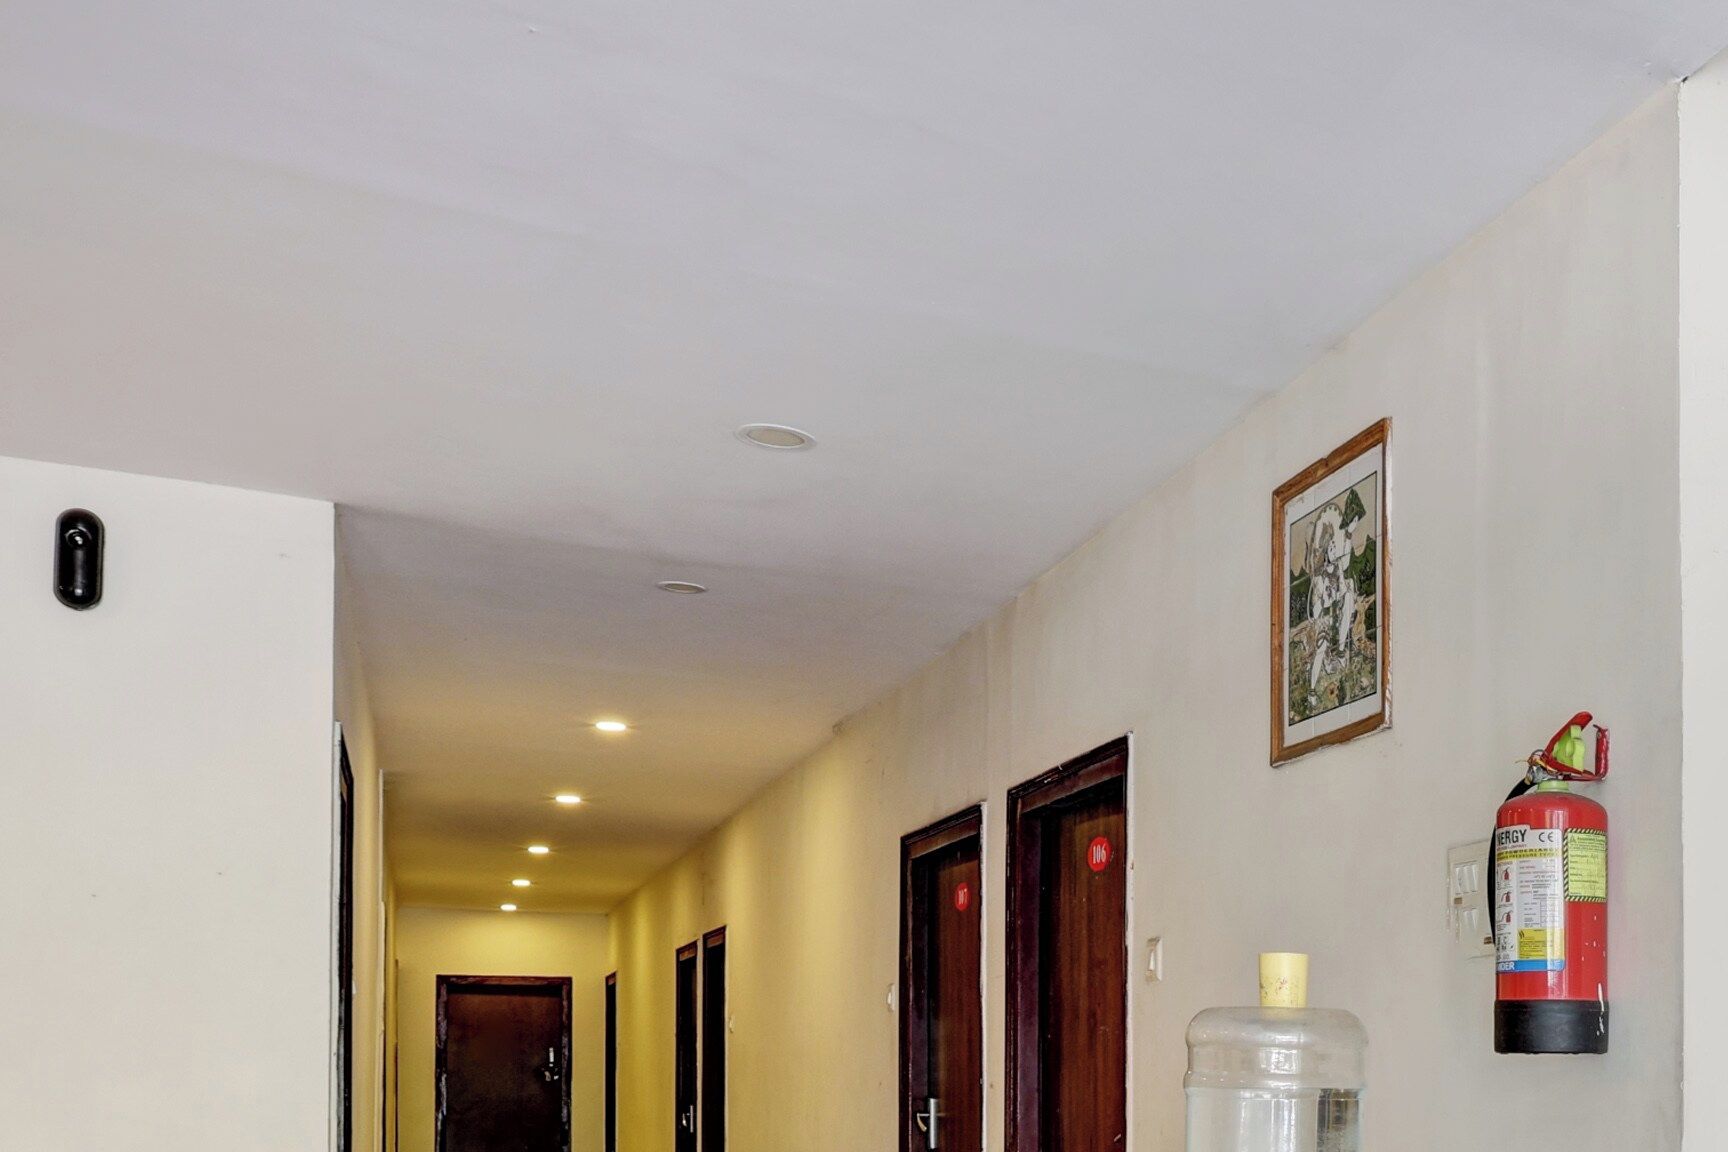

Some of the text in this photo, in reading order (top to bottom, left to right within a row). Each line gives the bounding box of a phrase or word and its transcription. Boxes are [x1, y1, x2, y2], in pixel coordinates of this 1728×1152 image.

[1538, 831, 1554, 842] CE
[1092, 843, 1107, 864] 106
[958, 888, 968, 905] 107
